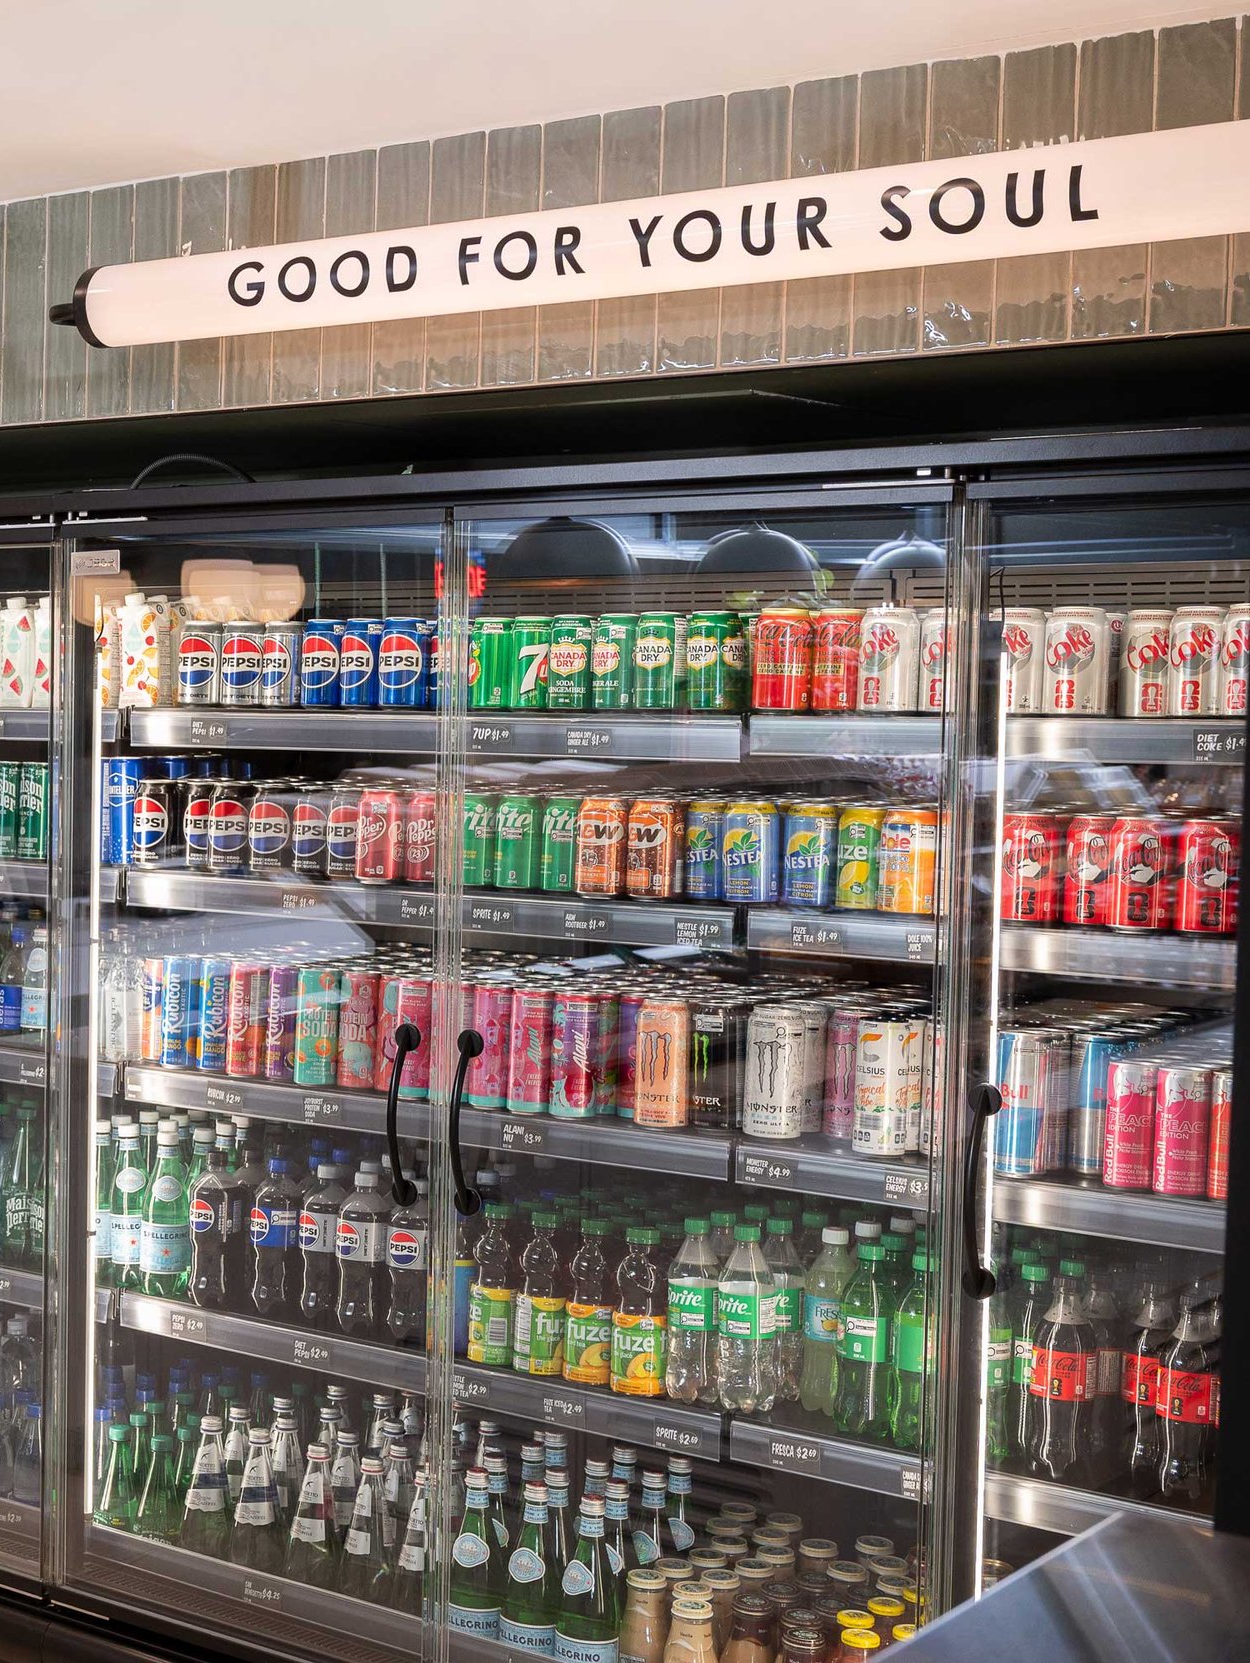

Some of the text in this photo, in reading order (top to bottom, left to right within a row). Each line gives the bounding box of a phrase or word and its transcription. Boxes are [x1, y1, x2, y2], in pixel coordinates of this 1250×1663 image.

[227, 165, 1100, 308] GOOD FOR YOUR SOUL
[1046, 625, 1095, 674] Coke
[1170, 626, 1221, 668] Coke
[178, 656, 215, 669] PEPSI
[222, 656, 262, 669] PEPSI
[379, 655, 420, 669] PEPSI
[551, 652, 587, 661] CANADA
[555, 680, 574, 688] SODA
[606, 680, 619, 688] ALE
[192, 721, 224, 738] DIET $1.49
[192, 727, 207, 735] PEPSI
[472, 727, 510, 741] 7UP $1.49
[567, 730, 610, 746] CANADA DRY $1.49
[581, 738, 589, 746] ALE
[1197, 734, 1220, 743] DIET
[1197, 742, 1222, 752] COKE
[249, 821, 288, 834] PEPSI
[414, 817, 434, 833] Dr
[881, 832, 911, 849] Dole
[784, 853, 830, 870] NESTEA
[283, 894, 316, 909] PEPSI $1.49
[283, 900, 296, 908] ZERO
[401, 905, 418, 914] PEPPER
[472, 908, 511, 922] SPRITE $1.49
[565, 920, 588, 929] ROOTBEER
[588, 919, 606, 931] $1.49
[677, 922, 719, 936] NESTLE $1.99
[677, 929, 697, 939] LEMON
[792, 934, 814, 944] ICE TEA
[793, 926, 838, 943] FUZE $1.49
[907, 934, 920, 943] DOLE
[677, 937, 703, 947] ICED TEA
[907, 943, 922, 952] JUICE
[162, 974, 182, 1035] Rubicon
[203, 976, 227, 1038] Rubicon
[227, 978, 245, 1042] Rubicon
[265, 982, 282, 1046] Rubicon
[302, 1020, 337, 1037] SODA
[571, 1029, 592, 1073] Alani
[856, 1064, 886, 1076] CELSIUS
[225, 1094, 241, 1104] $2.99
[304, 1104, 320, 1112] PROTEIN
[322, 1103, 339, 1115] $3.99
[503, 1123, 542, 1144] ALANI $3.99
[1108, 1124, 1136, 1133] EDITION
[1160, 1130, 1189, 1140] EDITION
[503, 1132, 514, 1143] NU
[1104, 1134, 1114, 1183] Red Bull
[746, 1157, 790, 1178] MONSTER $4.99
[746, 1164, 765, 1175] ENERGY
[1155, 1141, 1166, 1191] Red Bull
[885, 1175, 908, 1186] CELSIUS
[885, 1183, 907, 1194] ENERGY
[390, 1242, 419, 1254] PEPSI
[171, 1314, 203, 1331] PEPSI $2.49
[171, 1321, 184, 1332] ZERO
[568, 1318, 611, 1343] fuze
[614, 1327, 655, 1351] fuze
[294, 1340, 328, 1360] DIET $2.99
[294, 1349, 310, 1360] PEPSI
[459, 1389, 469, 1399] TEA
[468, 1383, 487, 1395] $2.99
[543, 1398, 583, 1415] FUZE $2.49
[543, 1404, 553, 1413] TEA
[655, 1427, 699, 1446] SPRITE $2.69
[771, 1442, 817, 1460] FRESCA $2.69
